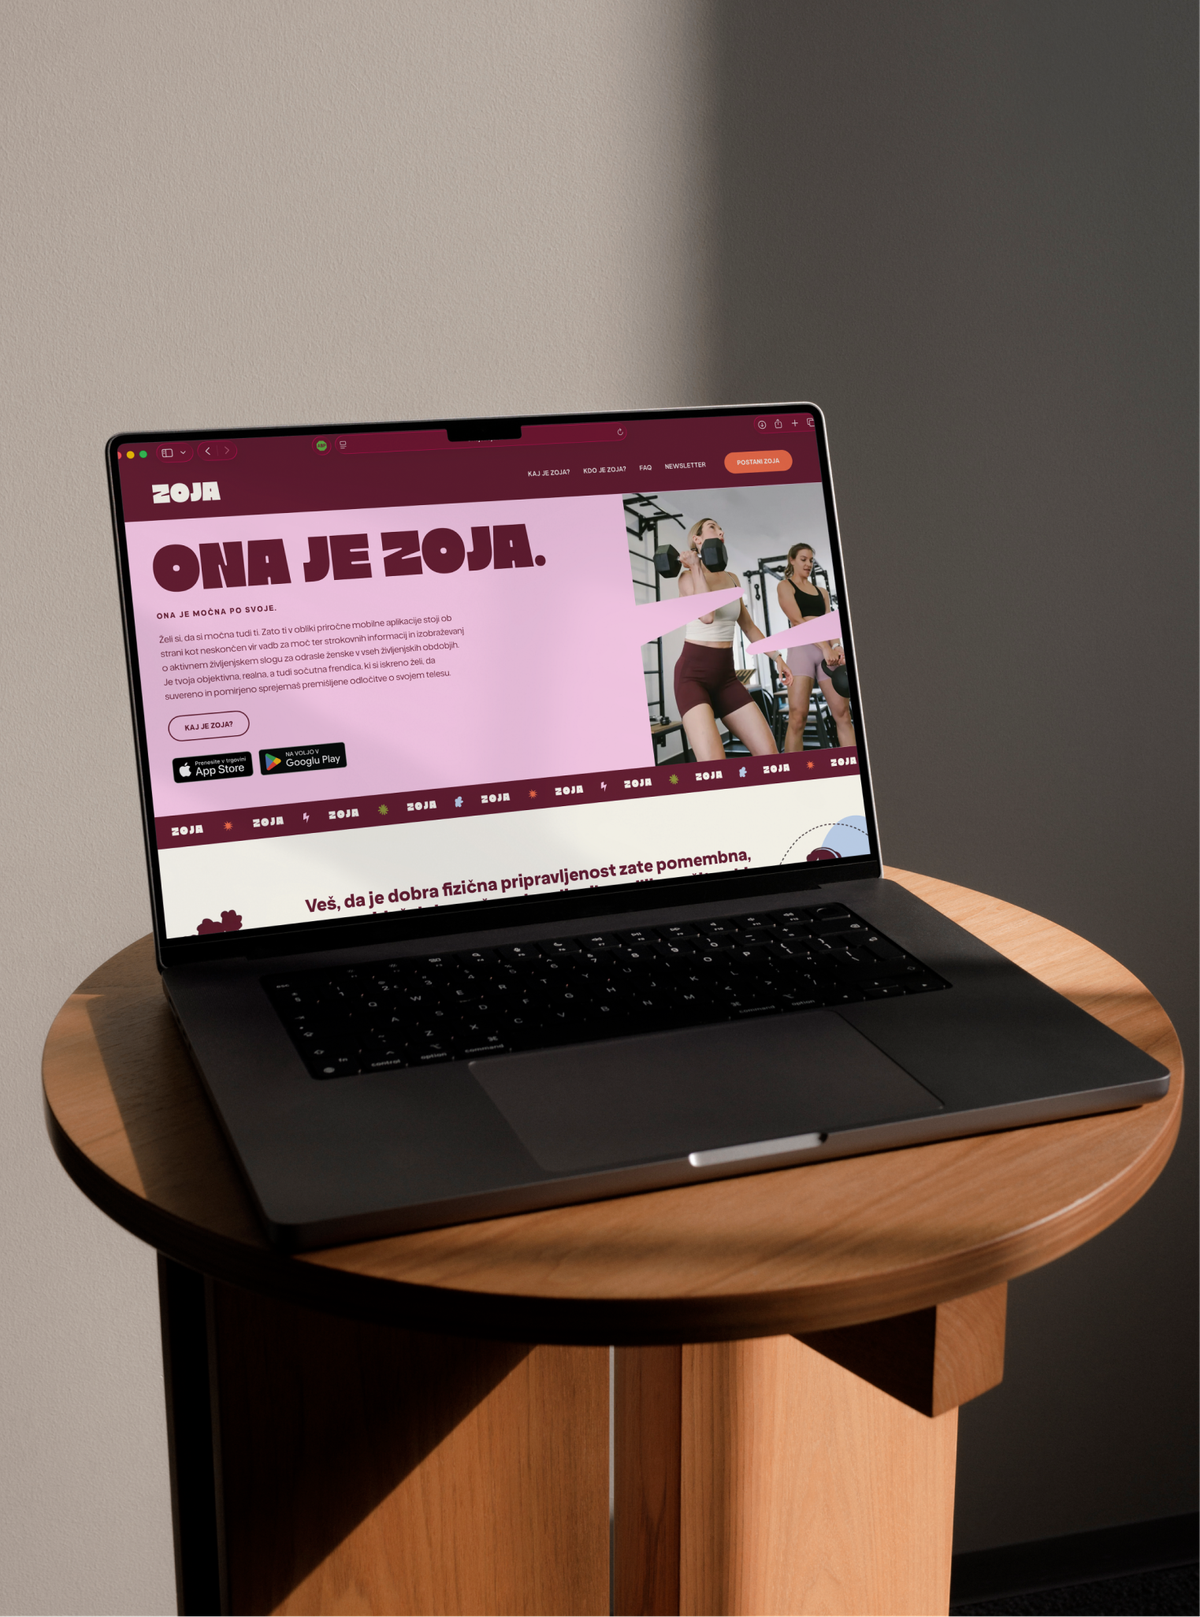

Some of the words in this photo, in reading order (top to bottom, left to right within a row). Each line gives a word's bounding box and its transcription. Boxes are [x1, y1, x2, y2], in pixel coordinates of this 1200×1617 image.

[152, 481, 220, 503] ZOJA
[152, 538, 291, 592] ONA
[303, 533, 372, 582] JE
[380, 523, 546, 577] ZOJA.
[192, 608, 226, 616] MOČNA
[245, 604, 276, 613] SVOJE.
[159, 635, 173, 643] Želi
[294, 625, 315, 633] obliki
[316, 623, 350, 633] priročne
[352, 620, 384, 628] mobilne
[386, 618, 422, 627] aplikacije
[160, 649, 183, 657] strani
[200, 645, 247, 654] neskončen
[324, 635, 366, 645] strokovnih
[367, 632, 407, 641] informacij
[416, 627, 464, 637] izobraževanj
[170, 662, 208, 671] aktivnem
[209, 658, 258, 668] življenjskem
[260, 656, 282, 664] slogu
[294, 652, 324, 661] odrasle
[326, 650, 354, 658] ženske
[381, 644, 421, 655] življenjskih
[422, 641, 459, 650] obdobjih.
[174, 676, 195, 685] tvoja
[196, 674, 241, 684] objektivna,
[276, 668, 292, 676] tudi
[293, 666, 327, 675] sočutna
[328, 664, 363, 672] frendica,
[380, 660, 409, 668] iskreno
[165, 691, 203, 700] suvereno
[213, 686, 257, 697] pomirjeno
[258, 682, 301, 693] sprejemaš
[302, 679, 348, 690] premišljene
[349, 675, 387, 684] odločitve
[395, 672, 424, 681] svojem
[196, 767, 216, 777] App
[218, 764, 244, 774] Store
[322, 755, 340, 764] Play
[171, 824, 203, 836] ZOJA
[252, 816, 284, 827] ZOJA
[328, 808, 359, 819] ZOJA
[406, 800, 436, 811] ZOJA
[481, 792, 510, 803] ZOJA
[555, 785, 583, 795] ZOJA
[624, 778, 652, 788] ZOJA
[695, 770, 722, 781] ZOJA
[763, 764, 790, 773] ZOJA
[830, 756, 856, 766] ZOJA
[305, 896, 340, 912] Veš,
[344, 893, 365, 908] da
[368, 891, 384, 909] je
[388, 886, 438, 902] dobra
[442, 879, 497, 896] fizična
[500, 864, 616, 893] pripravljenost
[619, 861, 653, 875] zate
[656, 850, 751, 874] pomembna,
[420, 1052, 447, 1060] option
[465, 1043, 504, 1053] command
[371, 1059, 400, 1067] control
